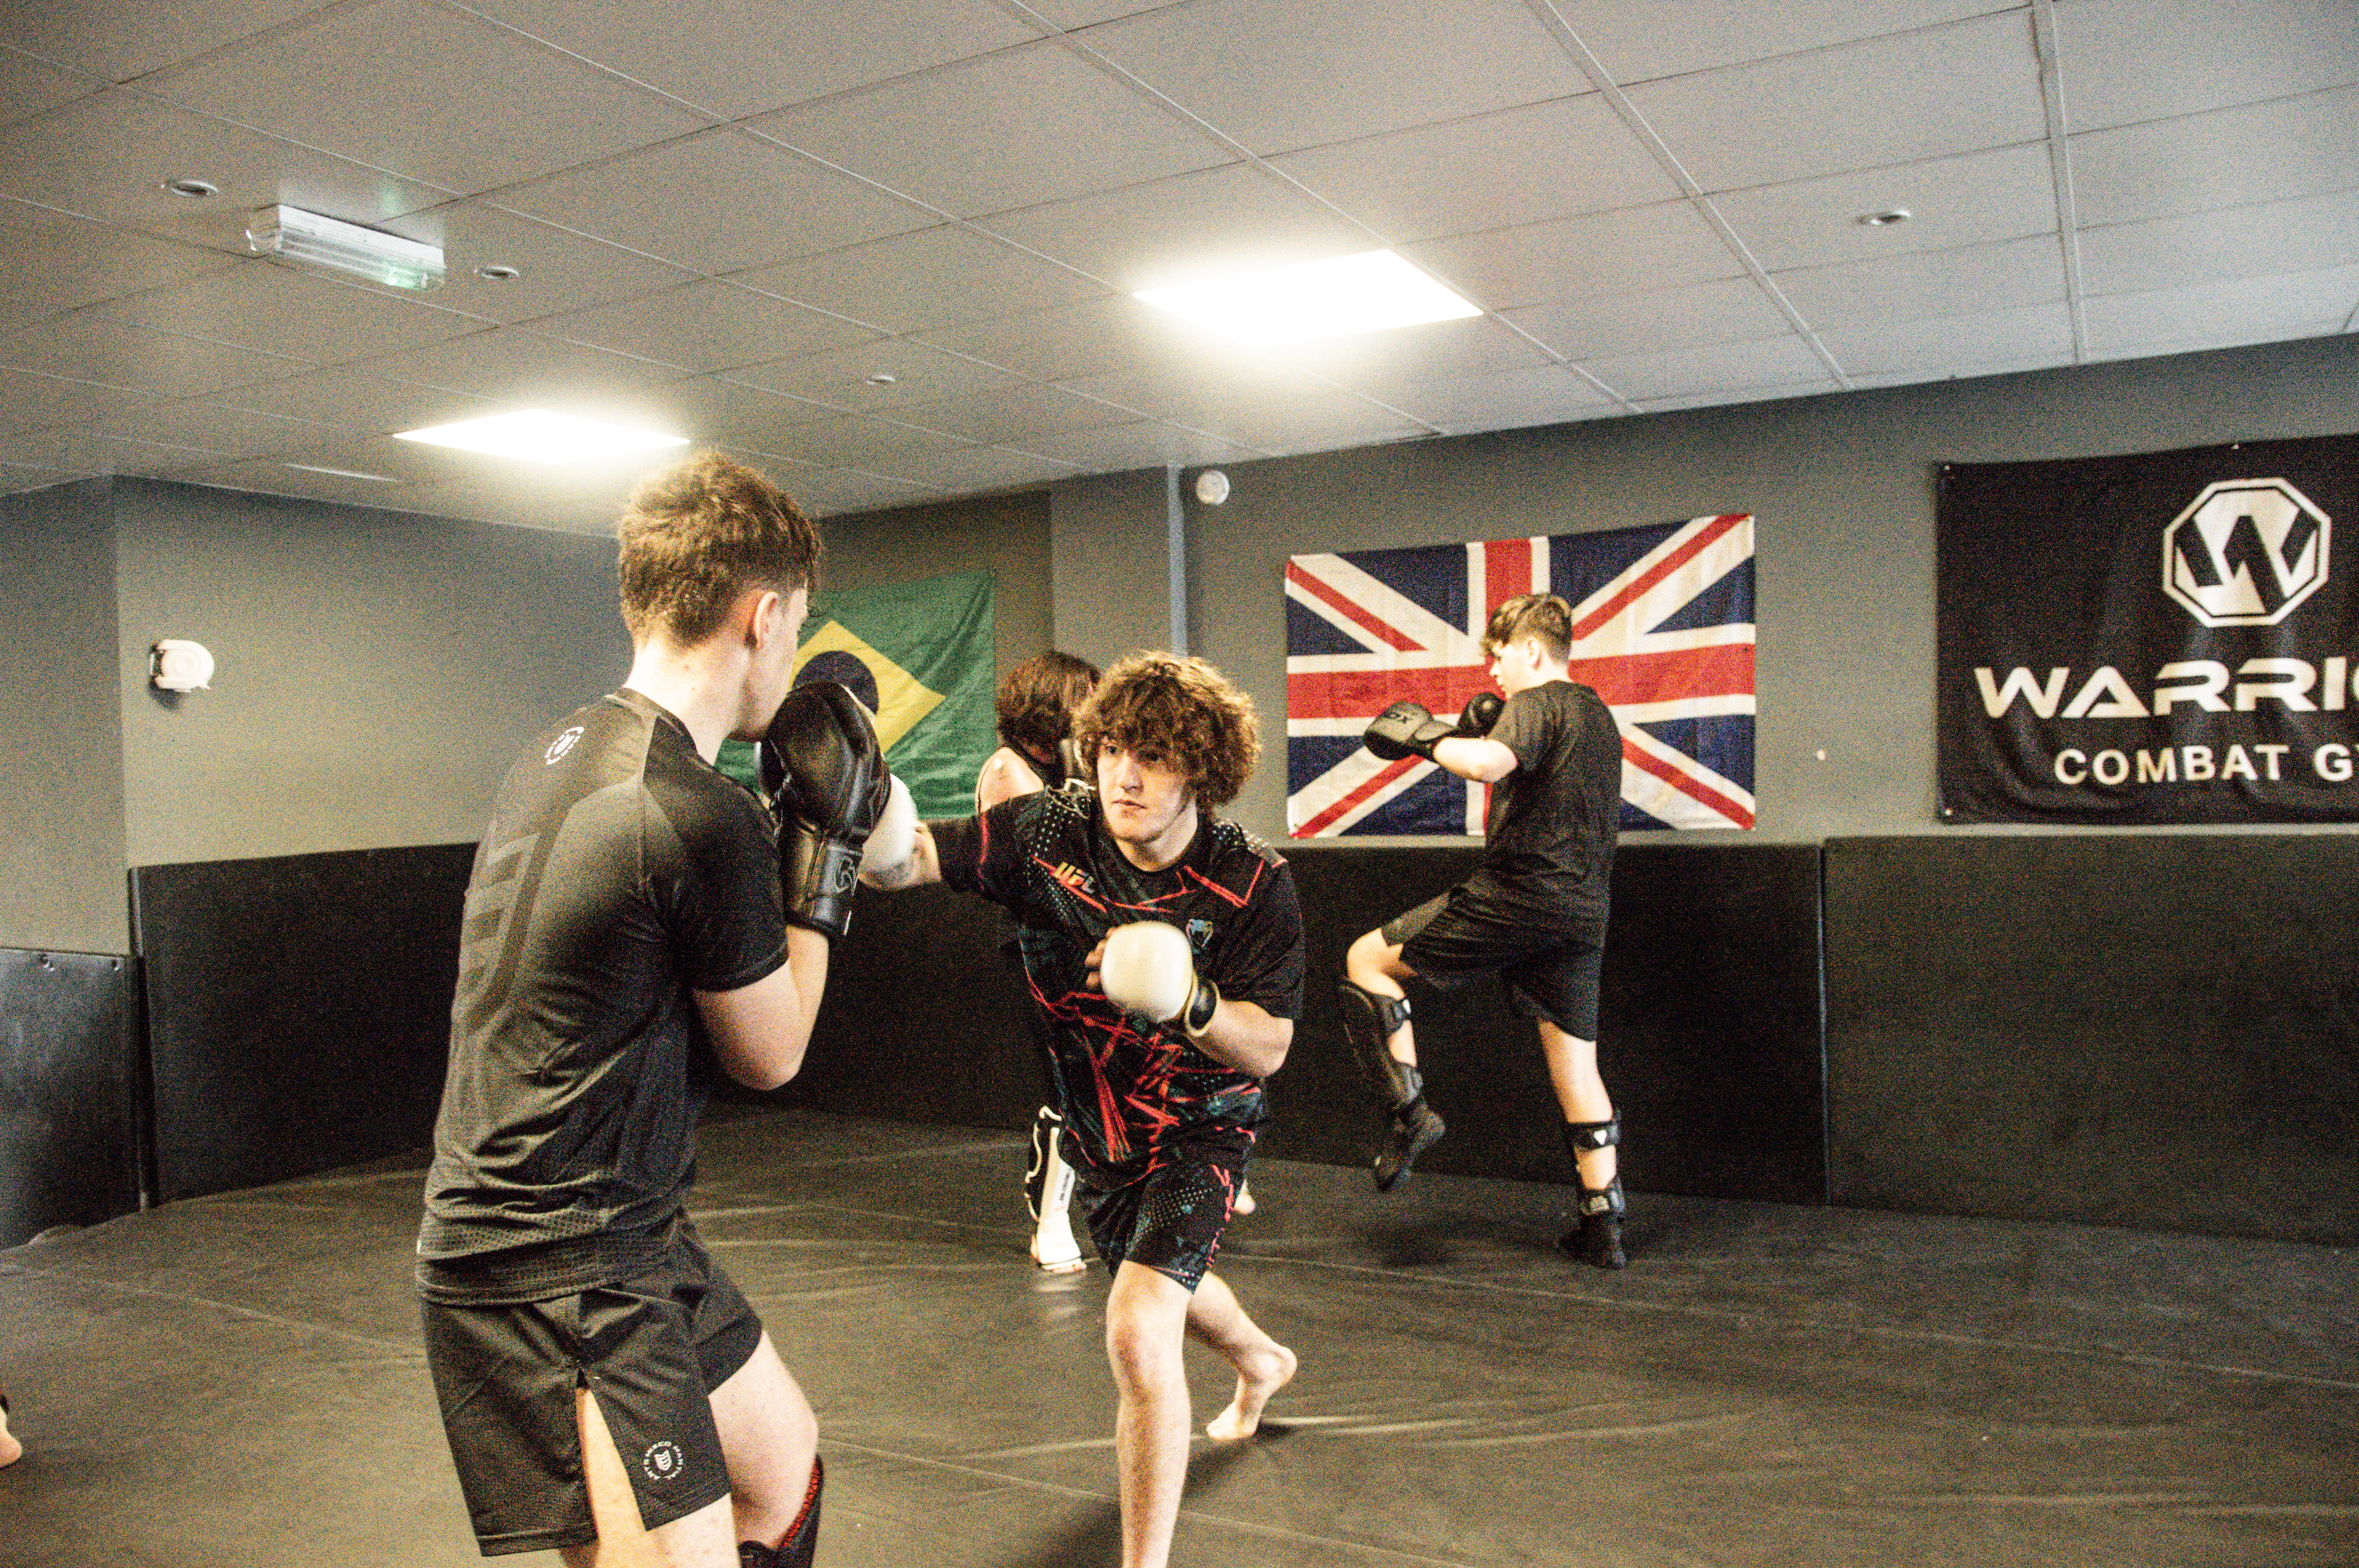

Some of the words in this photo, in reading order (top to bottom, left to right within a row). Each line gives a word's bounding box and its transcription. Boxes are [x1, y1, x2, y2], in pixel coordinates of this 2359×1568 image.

[1974, 657, 2359, 718] WARRI
[2054, 744, 2289, 784] COMBAT
[2314, 744, 2359, 781] G
